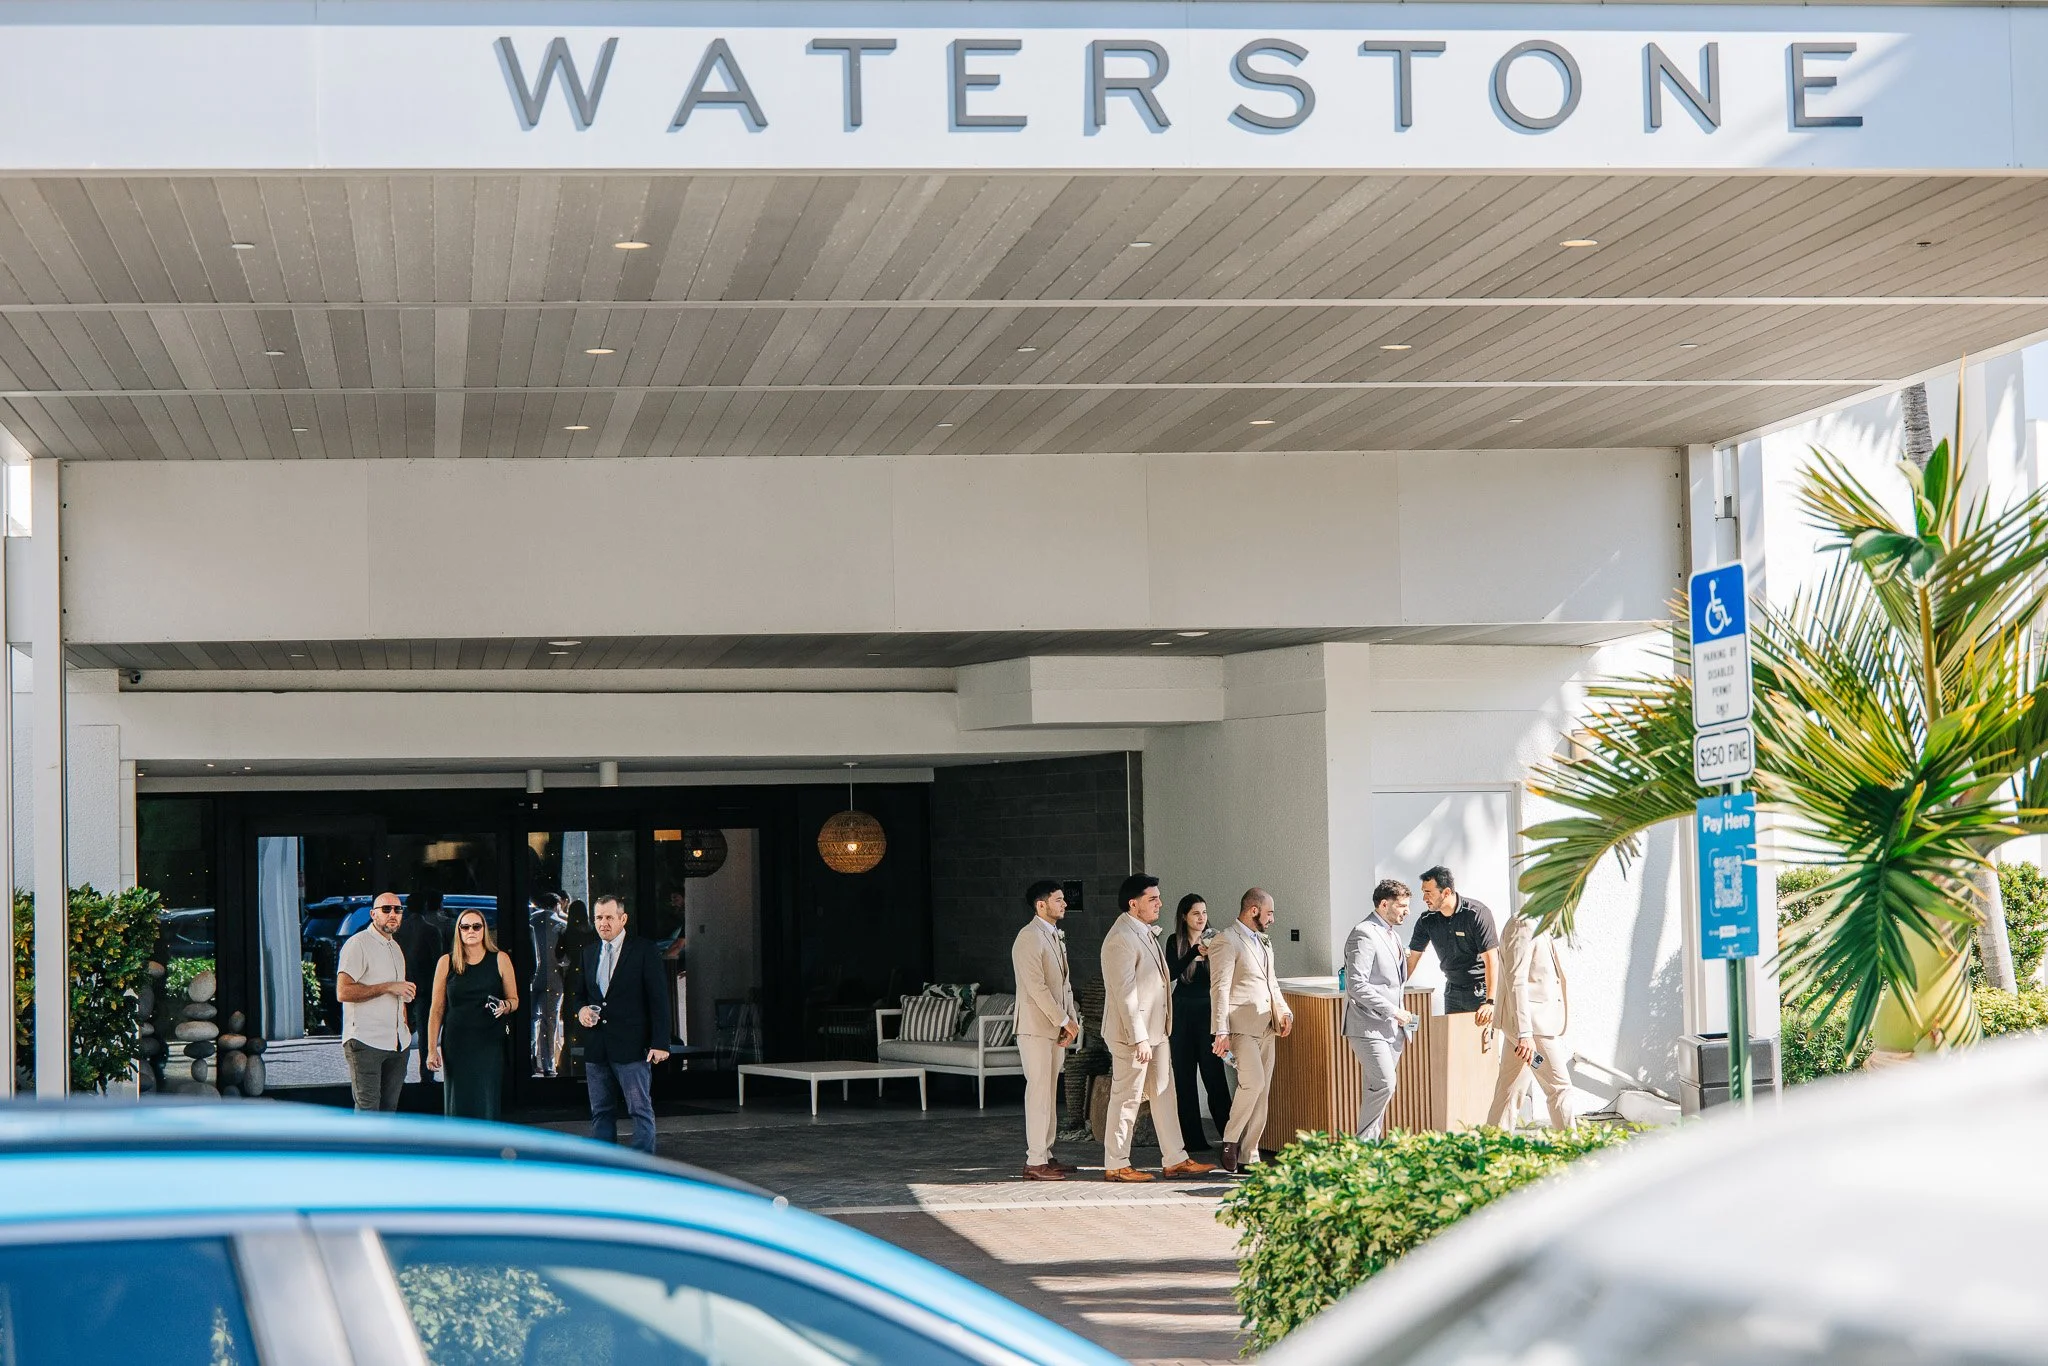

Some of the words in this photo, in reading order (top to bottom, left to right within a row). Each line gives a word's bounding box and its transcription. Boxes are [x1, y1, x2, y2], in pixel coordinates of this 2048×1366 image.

[494, 35, 1863, 131] WATERSTONE
[1703, 649, 1726, 663] PARKING
[1730, 646, 1737, 659] BY
[1708, 665, 1734, 680] DISABLED
[1712, 683, 1731, 697] PERMIT
[1716, 702, 1729, 716] ONLY
[1700, 745, 1724, 769] $250
[1728, 741, 1748, 762] FINE
[1703, 814, 1723, 835] Pay
[1724, 812, 1750, 830] Here
